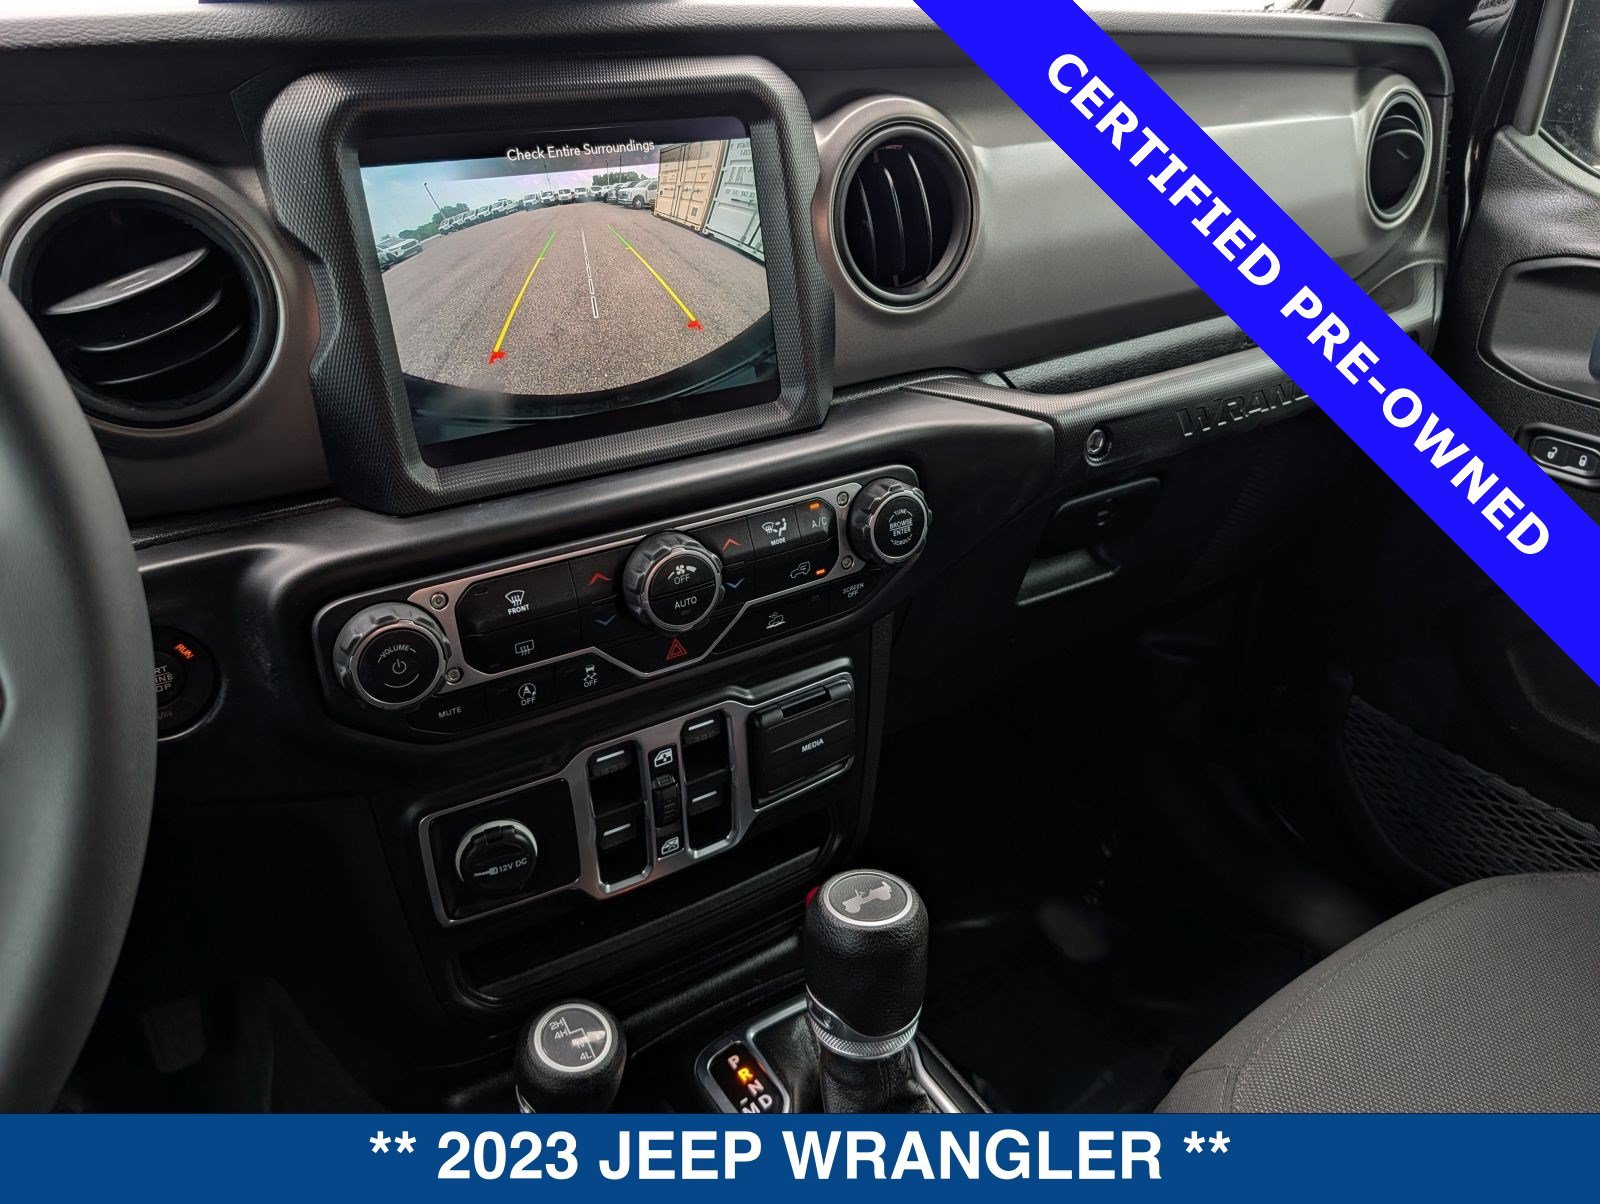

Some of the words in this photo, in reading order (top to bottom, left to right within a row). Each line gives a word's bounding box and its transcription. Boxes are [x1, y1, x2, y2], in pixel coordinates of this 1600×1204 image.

[506, 146, 545, 162] Check
[547, 144, 581, 159] Entire
[583, 139, 655, 156] Surroundings
[1175, 379, 1309, 437] WRAN
[893, 508, 907, 516] TUNE
[811, 516, 828, 529] A/C
[889, 517, 913, 529] BROWSE
[892, 526, 912, 537] ENTER
[770, 537, 786, 546] MODE
[673, 573, 691, 586] OFF
[842, 582, 865, 594] SCREEN
[847, 589, 859, 598] OFF
[673, 595, 698, 610] AUTO
[507, 603, 530, 616] FRONT
[174, 643, 195, 660] RUN
[379, 644, 411, 659] VOLUME
[154, 673, 174, 683] INE
[583, 678, 598, 689] OFF
[520, 696, 536, 707] OFF
[438, 706, 463, 719] MUTE
[801, 738, 825, 753] MEDIA
[498, 861, 514, 874] 12V
[514, 856, 528, 869] DC
[549, 1018, 564, 1031] 2H
[554, 1028, 569, 1040] 4H
[580, 1051, 593, 1061] 4L
[727, 1054, 740, 1070] P
[737, 1067, 754, 1083] R
[747, 1078, 764, 1096] N
[757, 1094, 773, 1110] D
